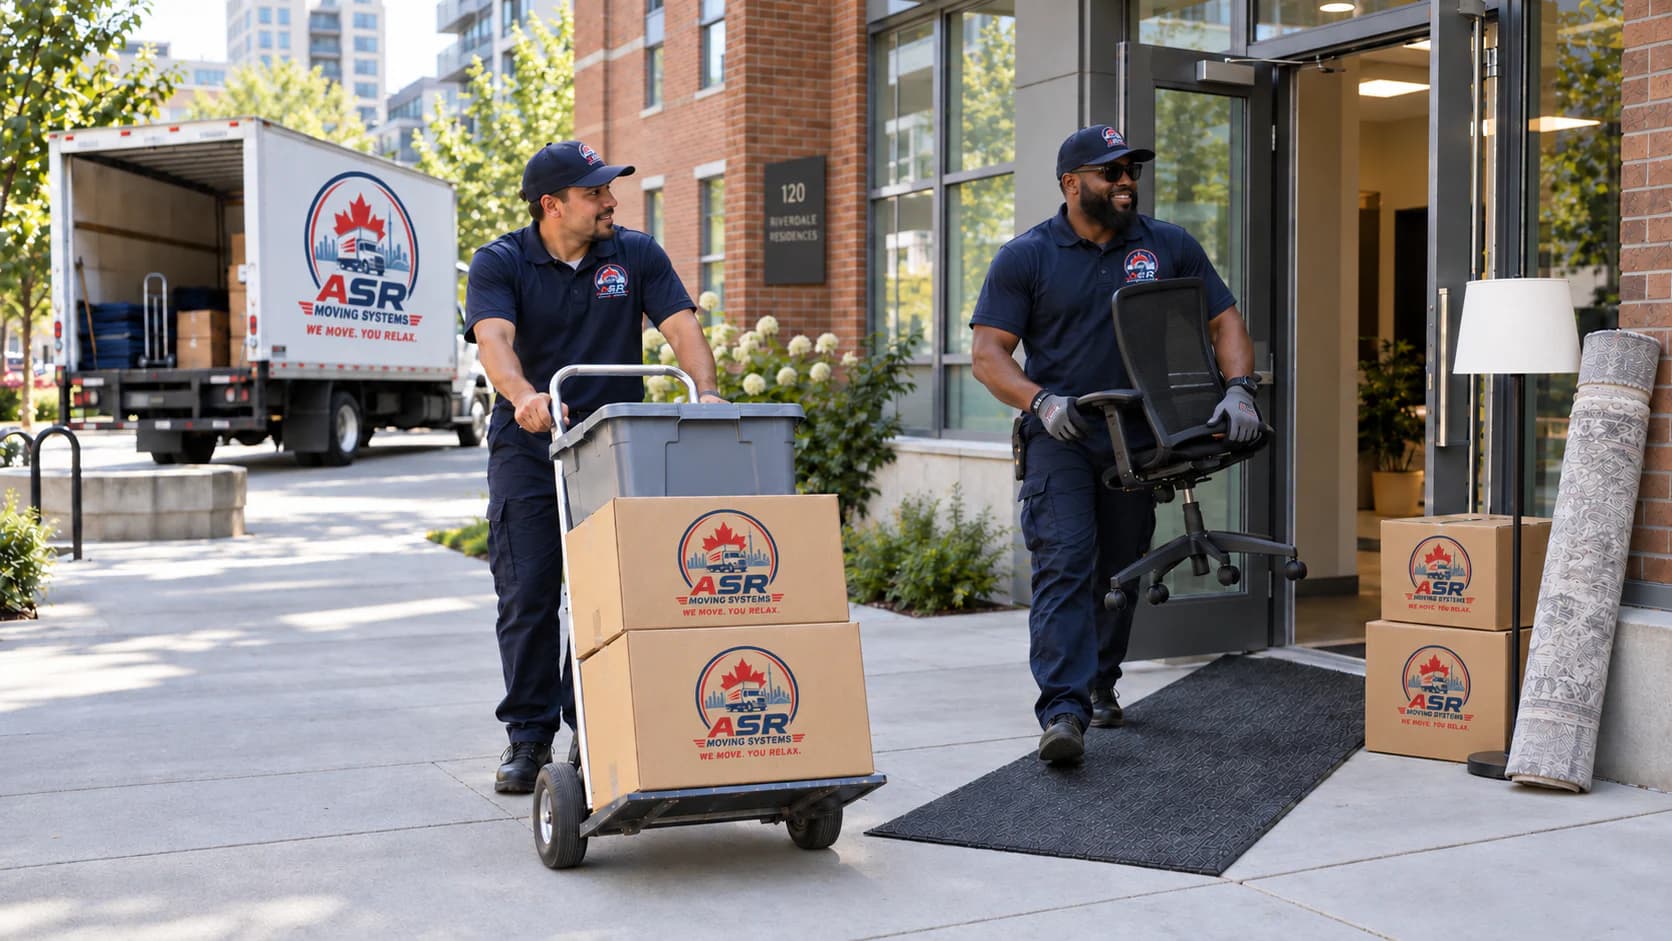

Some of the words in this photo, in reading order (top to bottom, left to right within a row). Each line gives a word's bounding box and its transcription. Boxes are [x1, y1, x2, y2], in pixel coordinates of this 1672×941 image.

[781, 182, 806, 204] 120
[769, 214, 817, 227] RIVERDALE
[769, 230, 818, 242] RESIDENCES
[316, 273, 407, 312] ASR
[314, 305, 359, 320] MOVING
[361, 310, 409, 325] SYSTEMS
[306, 324, 322, 336] WE
[325, 326, 358, 339] MOVE.
[361, 328, 381, 340] YOU
[384, 331, 417, 343] RELAX.
[690, 574, 769, 596] ASR
[1415, 580, 1465, 596] ASR
[688, 596, 726, 605] MOVING
[728, 595, 771, 604] SYSTEMS
[683, 608, 696, 616] WE
[698, 608, 726, 616] MOVE.
[728, 607, 746, 615] YOU
[749, 606, 780, 615] RELAX.
[1408, 693, 1463, 713] ASR
[708, 713, 789, 738] ASR
[706, 737, 745, 748] MOVING
[747, 735, 792, 746] SYSTEMS
[699, 752, 714, 761] WE
[716, 750, 745, 760] MOVE.
[747, 749, 766, 757] YOU
[769, 747, 801, 757] RELAX.
